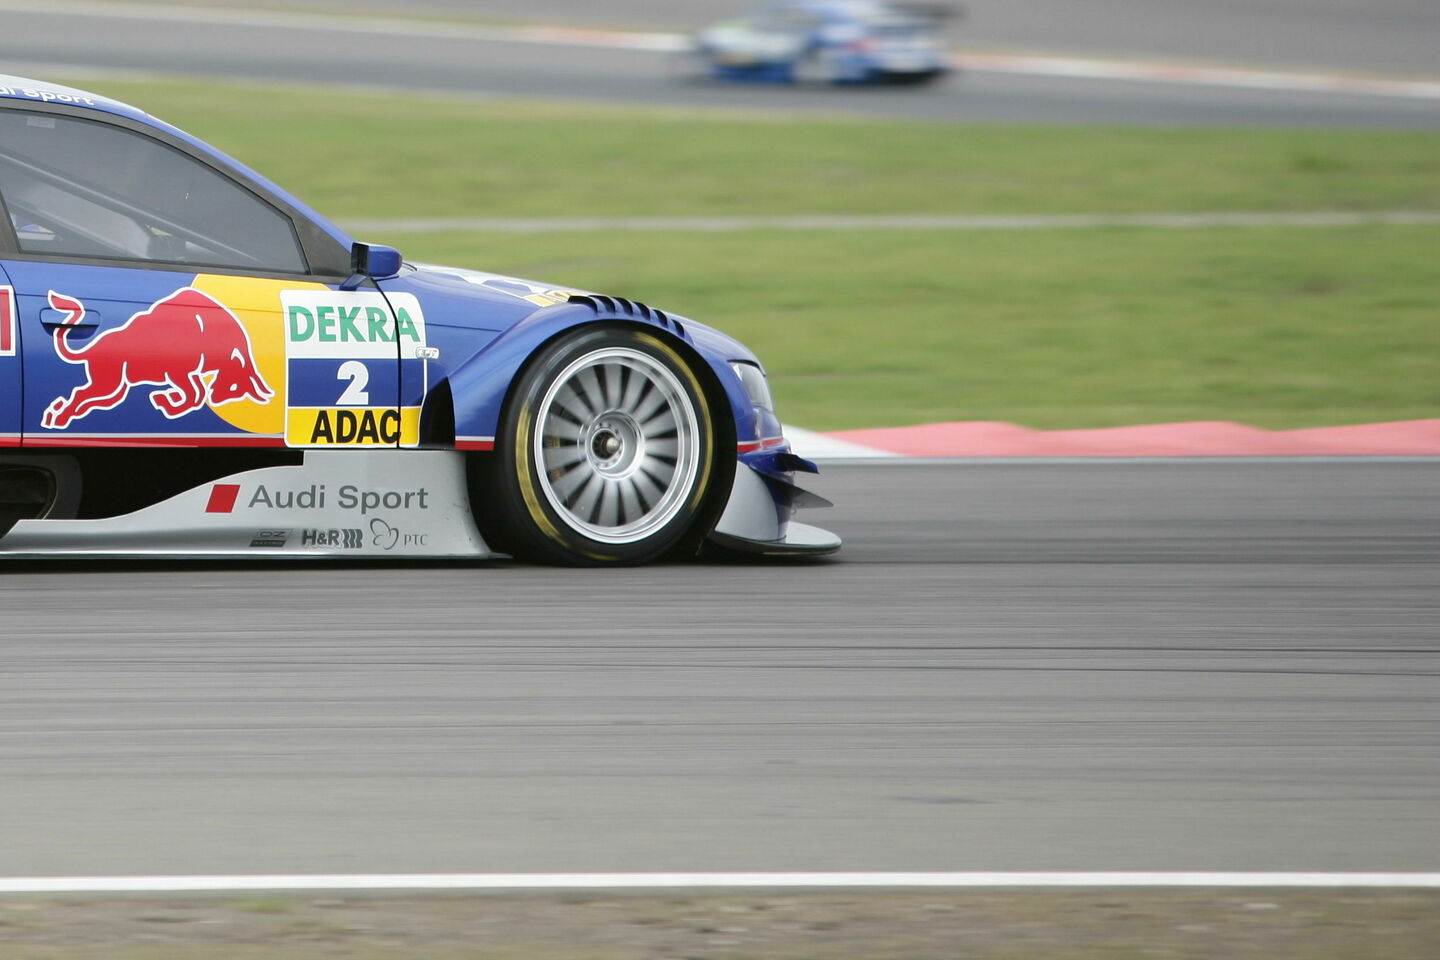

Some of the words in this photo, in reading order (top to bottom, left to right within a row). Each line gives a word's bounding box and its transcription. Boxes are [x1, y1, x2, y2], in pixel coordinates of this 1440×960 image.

[21, 88, 95, 106] Sport
[288, 306, 421, 343] DEKRA
[335, 360, 370, 406] 2
[310, 409, 402, 444] ADAC
[248, 484, 326, 509] Audi
[337, 484, 429, 515] Sport
[302, 528, 340, 546] H&R
[404, 534, 429, 546] PTC
